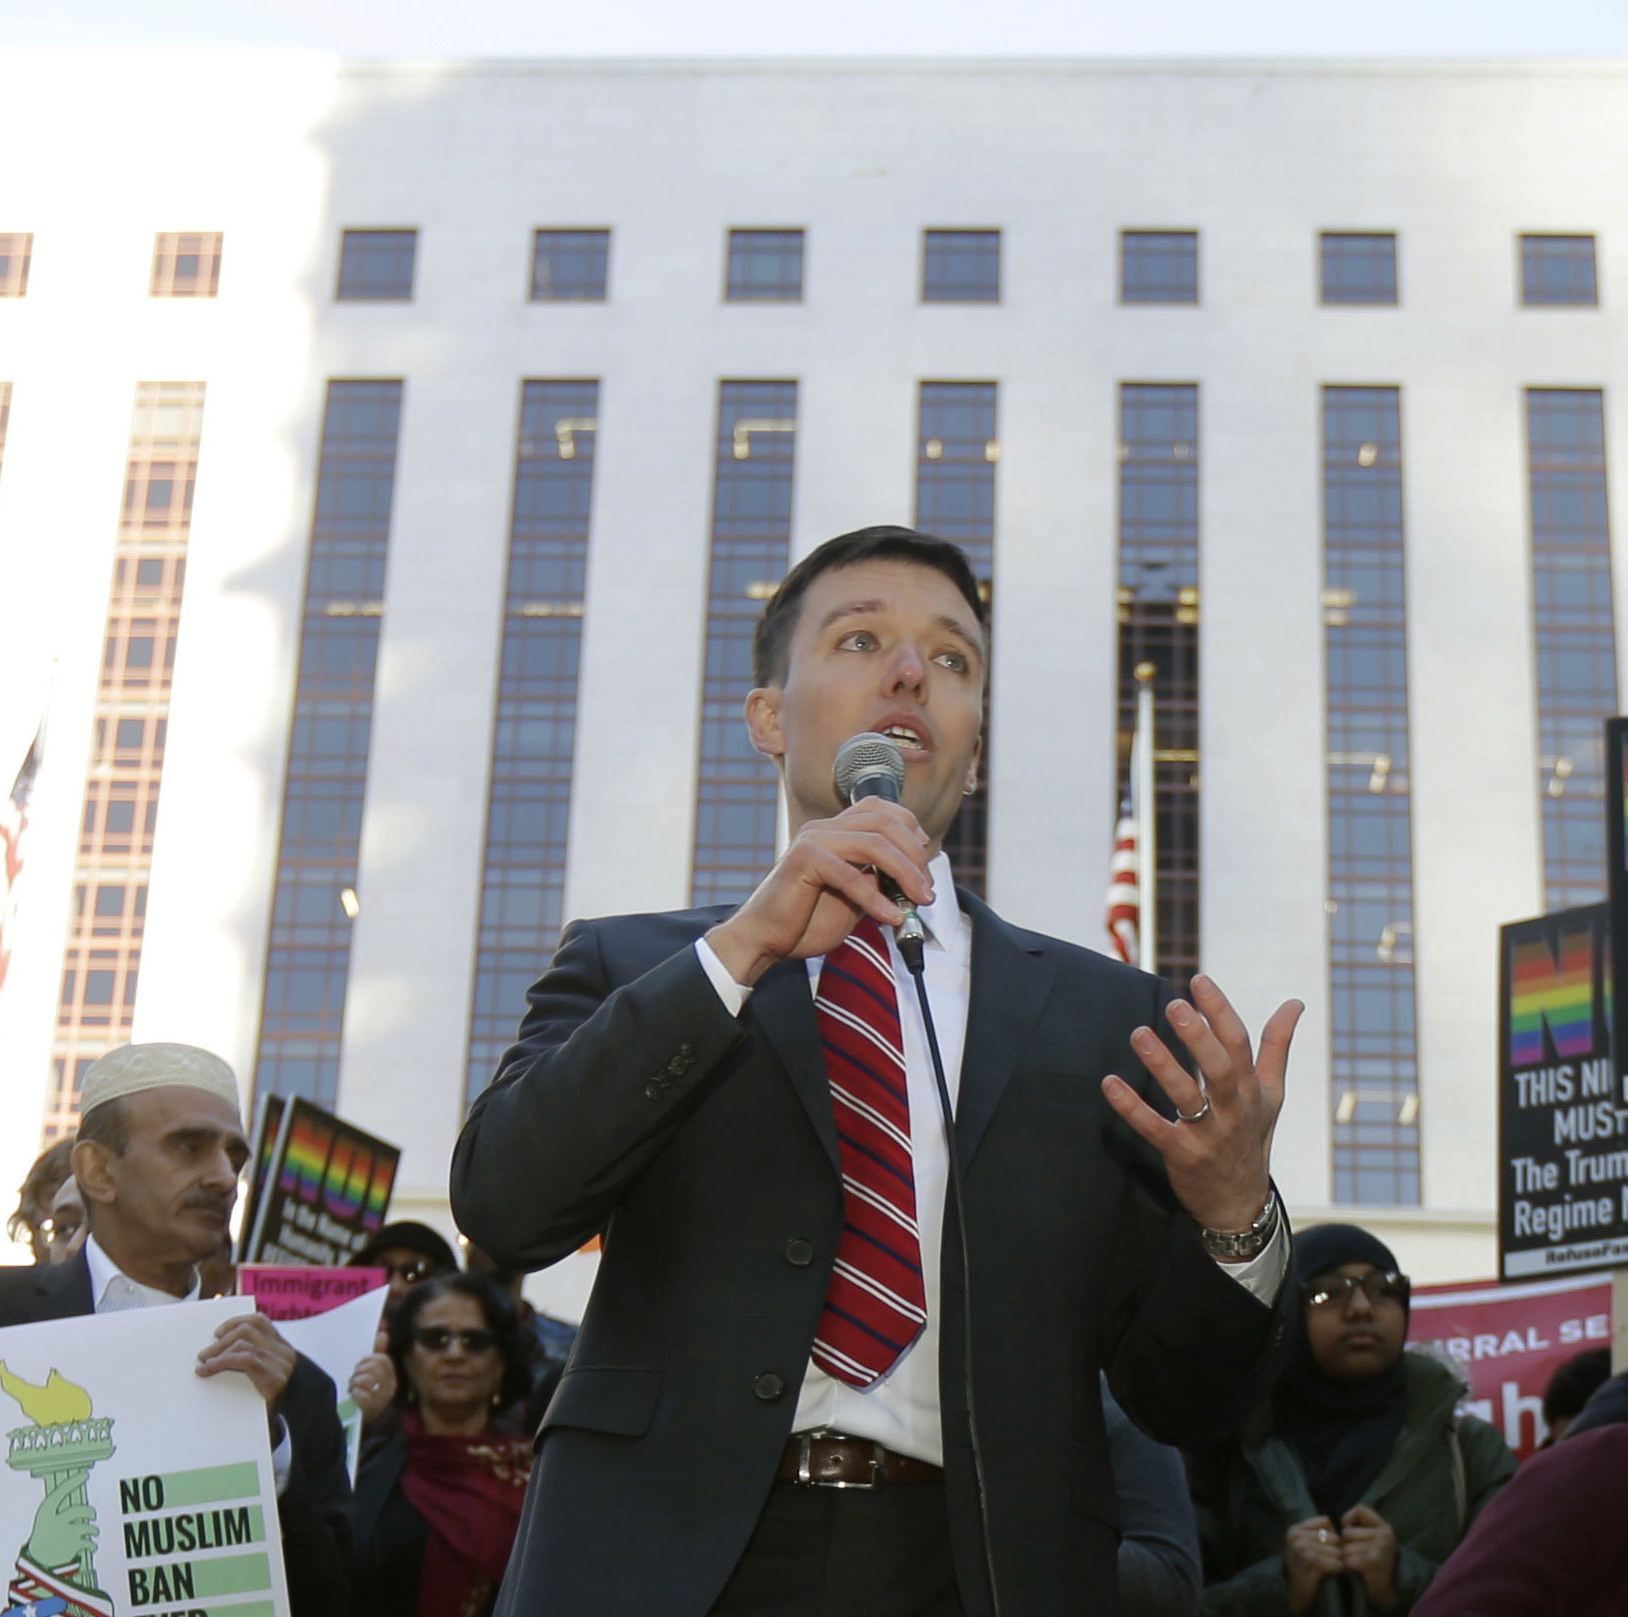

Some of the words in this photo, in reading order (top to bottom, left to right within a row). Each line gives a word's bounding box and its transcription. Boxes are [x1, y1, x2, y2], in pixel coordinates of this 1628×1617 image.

[1514, 1065, 1575, 1108] THIS
[1554, 1101, 1626, 1145] MUST
[1511, 1157, 1558, 1193] The
[1514, 1195, 1614, 1241] Regime
[253, 1272, 368, 1301] Immigrant
[120, 1475, 164, 1514] NO
[123, 1507, 251, 1559] MUSLIM
[128, 1561, 195, 1606] BAN
